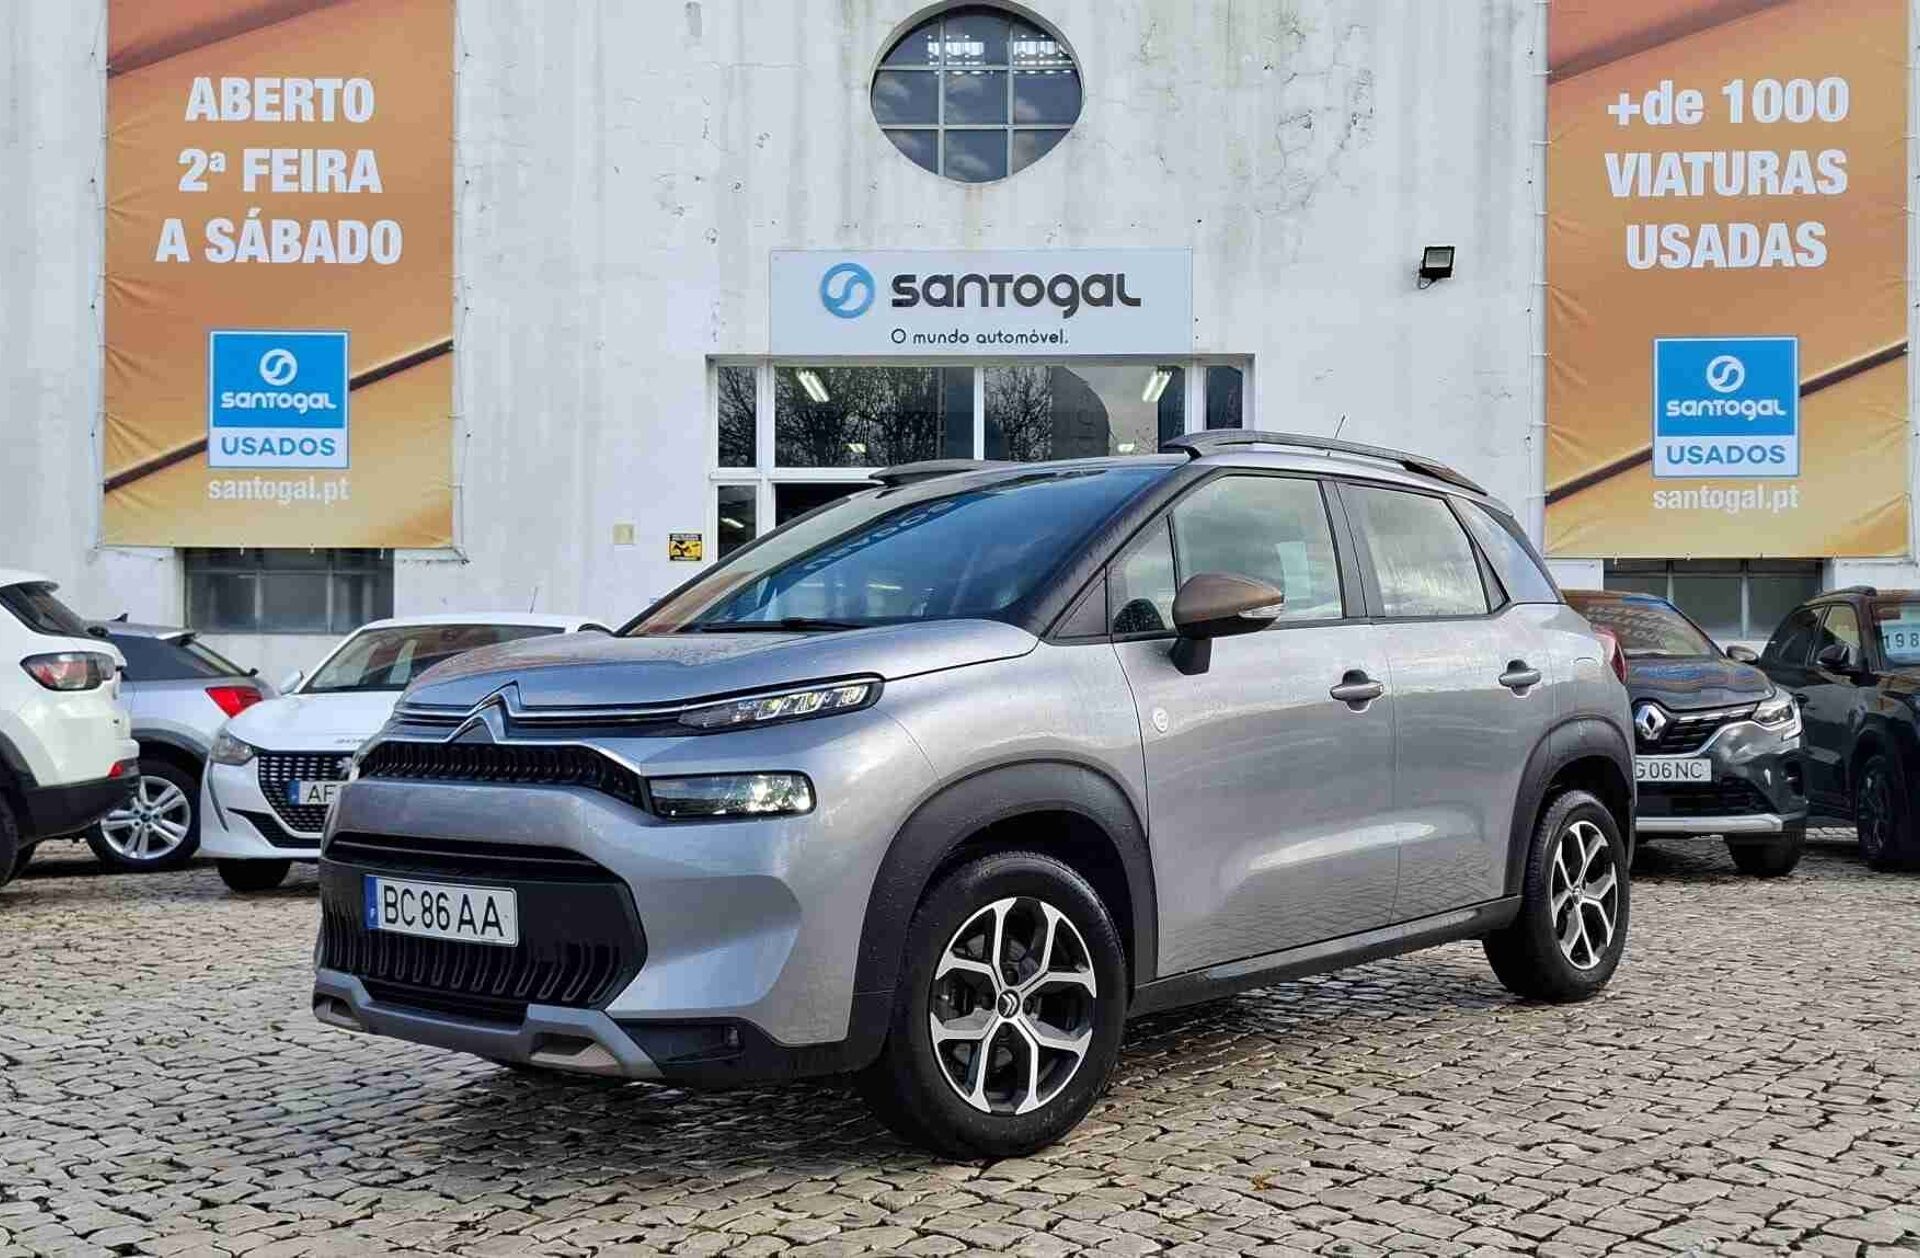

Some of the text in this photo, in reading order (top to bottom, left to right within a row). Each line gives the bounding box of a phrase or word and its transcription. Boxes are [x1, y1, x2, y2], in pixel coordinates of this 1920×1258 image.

[184, 76, 375, 123] ABERTO
[1607, 76, 1850, 126] +de 1000
[178, 148, 383, 193] 2ª FEIRA
[1604, 148, 1848, 198] VIATURAS
[155, 207, 402, 265] A SÁBADO
[1626, 221, 1828, 270] USADAS
[891, 327, 1069, 345] O mundo automóvel.
[221, 436, 336, 457] USADOS
[1666, 444, 1786, 465] USADOS
[208, 475, 350, 505] santogal.pt
[1653, 484, 1799, 515] santogal.pt
[1649, 762, 1673, 779] 06
[1675, 762, 1702, 779] NC
[383, 885, 504, 937] BC 86 AA
